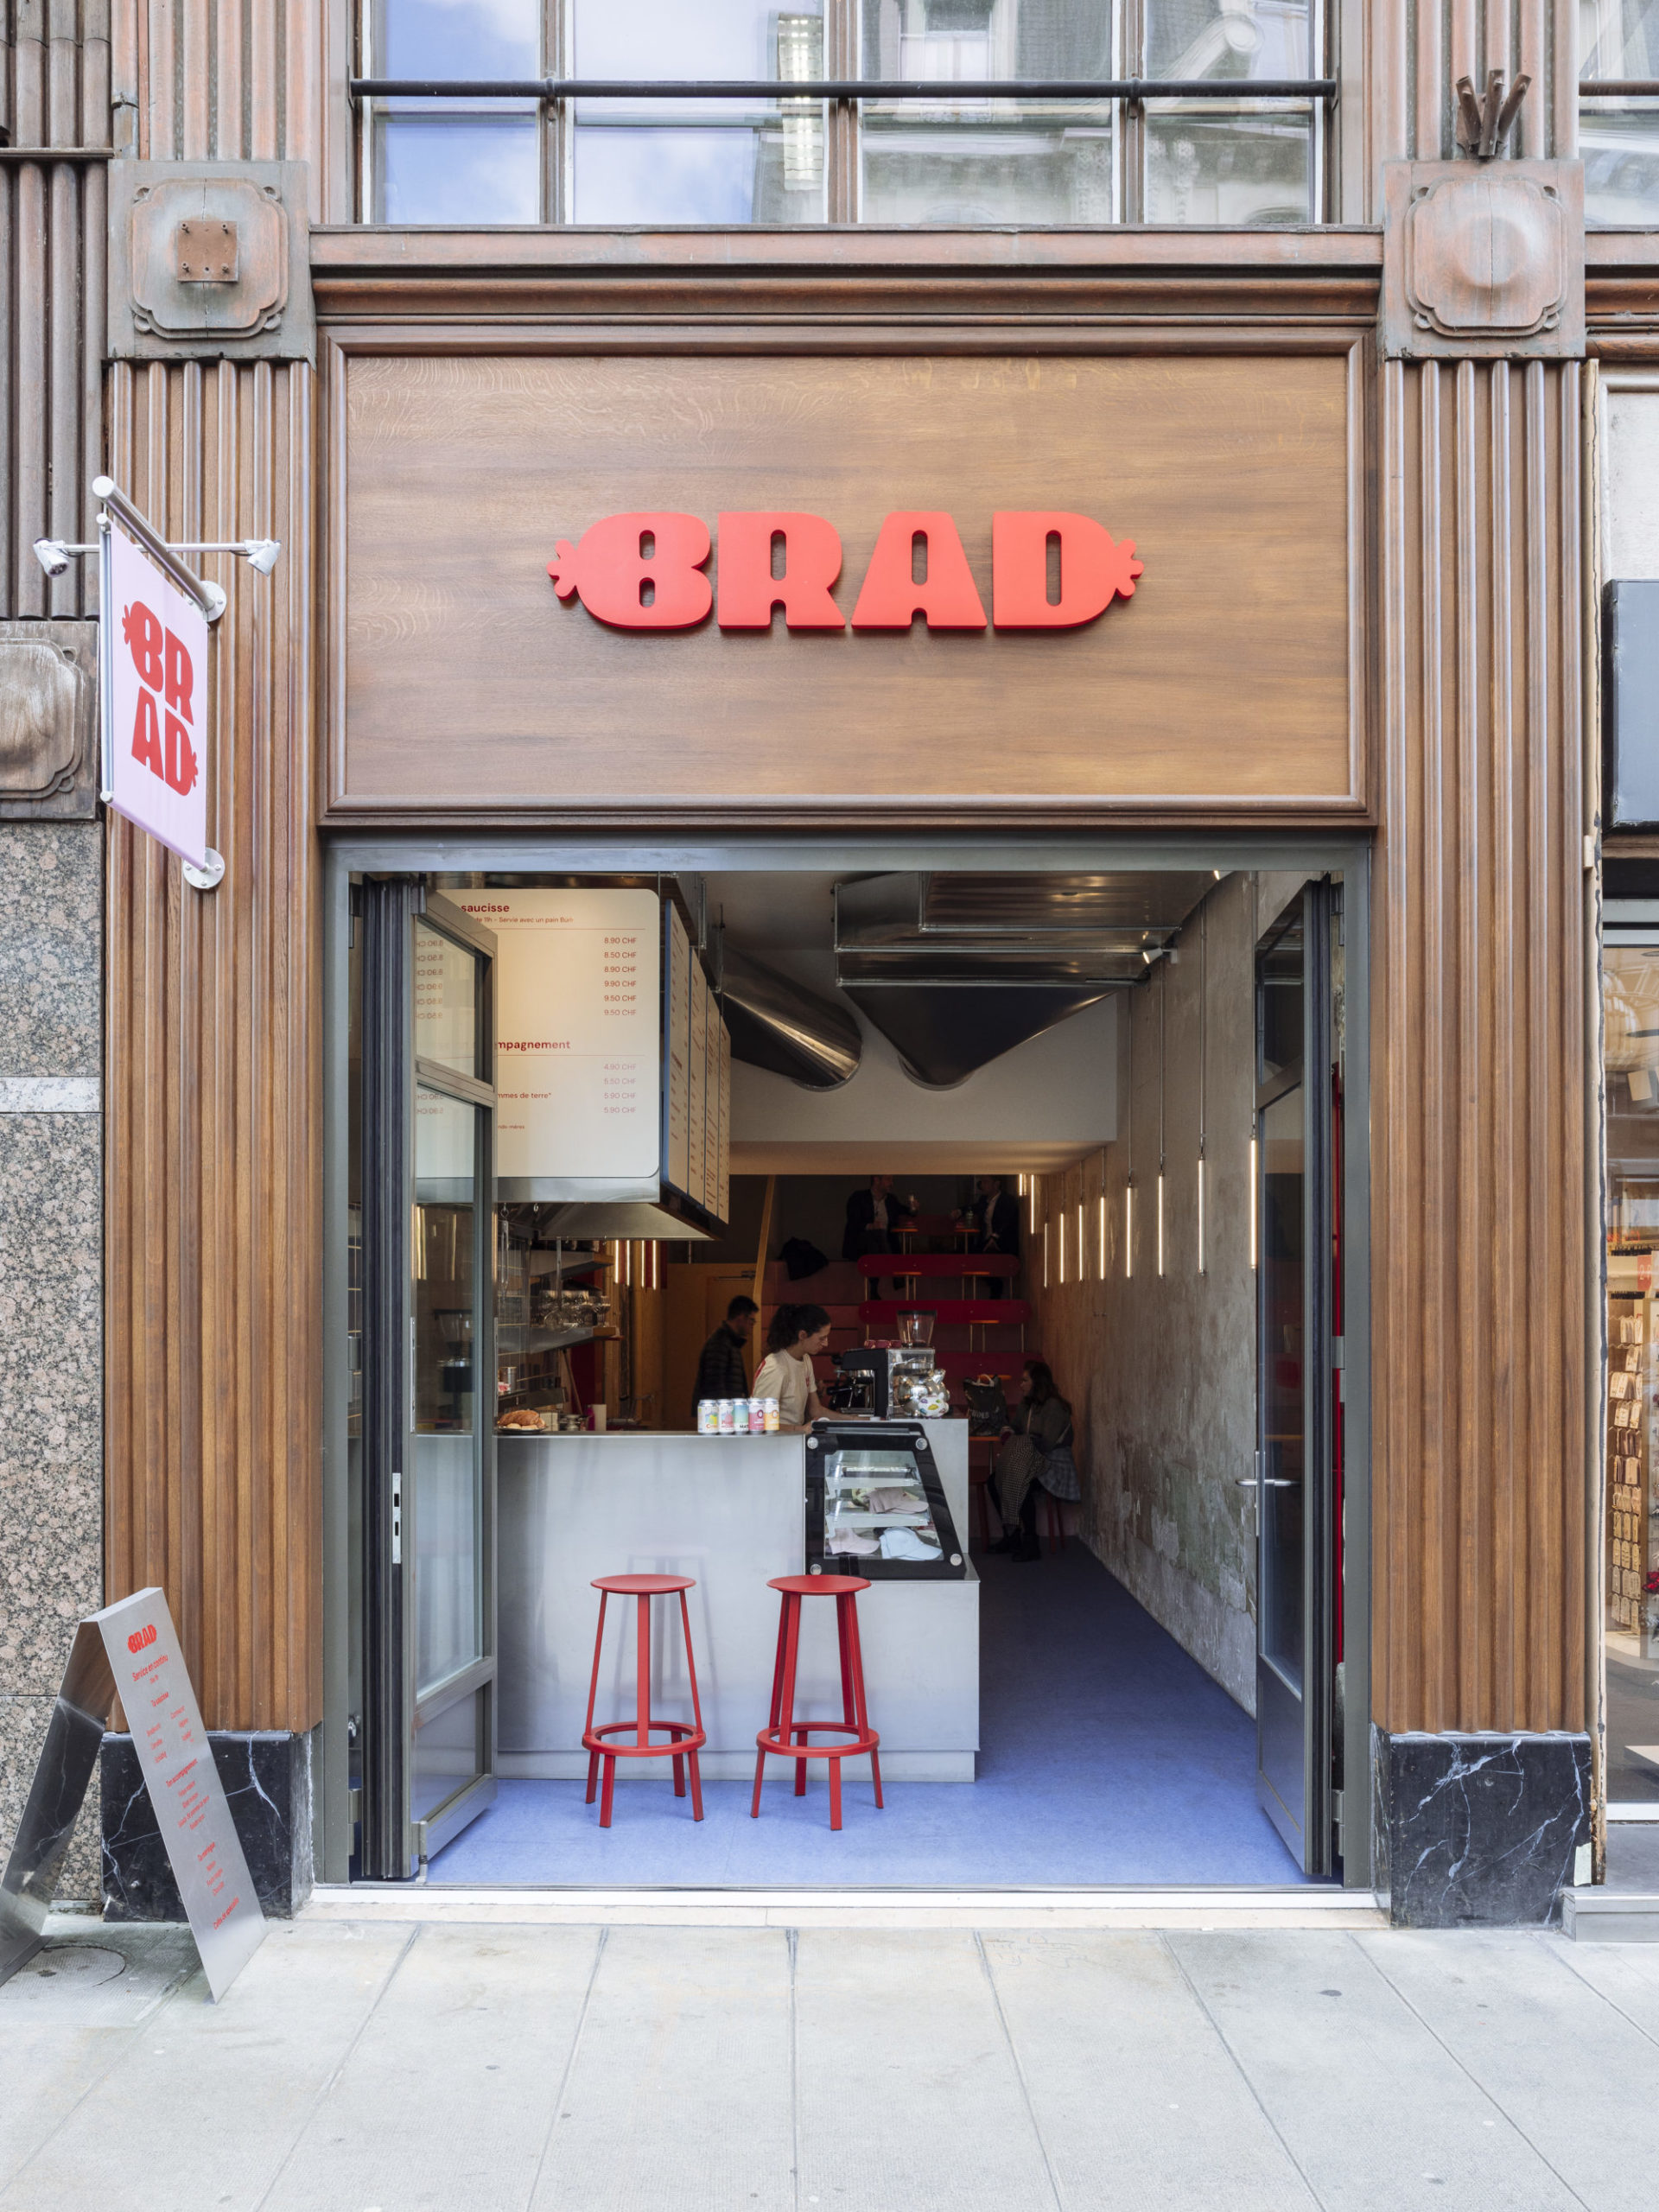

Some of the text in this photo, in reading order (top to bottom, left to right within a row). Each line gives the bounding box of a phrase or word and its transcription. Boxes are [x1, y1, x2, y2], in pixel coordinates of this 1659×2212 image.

[546, 511, 1143, 629] BRAD
[461, 903, 510, 912] saucisse
[498, 1040, 570, 1051] mpagnement
[128, 1624, 157, 1654] BRAD
[132, 1667, 149, 1681] Service
[154, 1655, 168, 1668] continu
